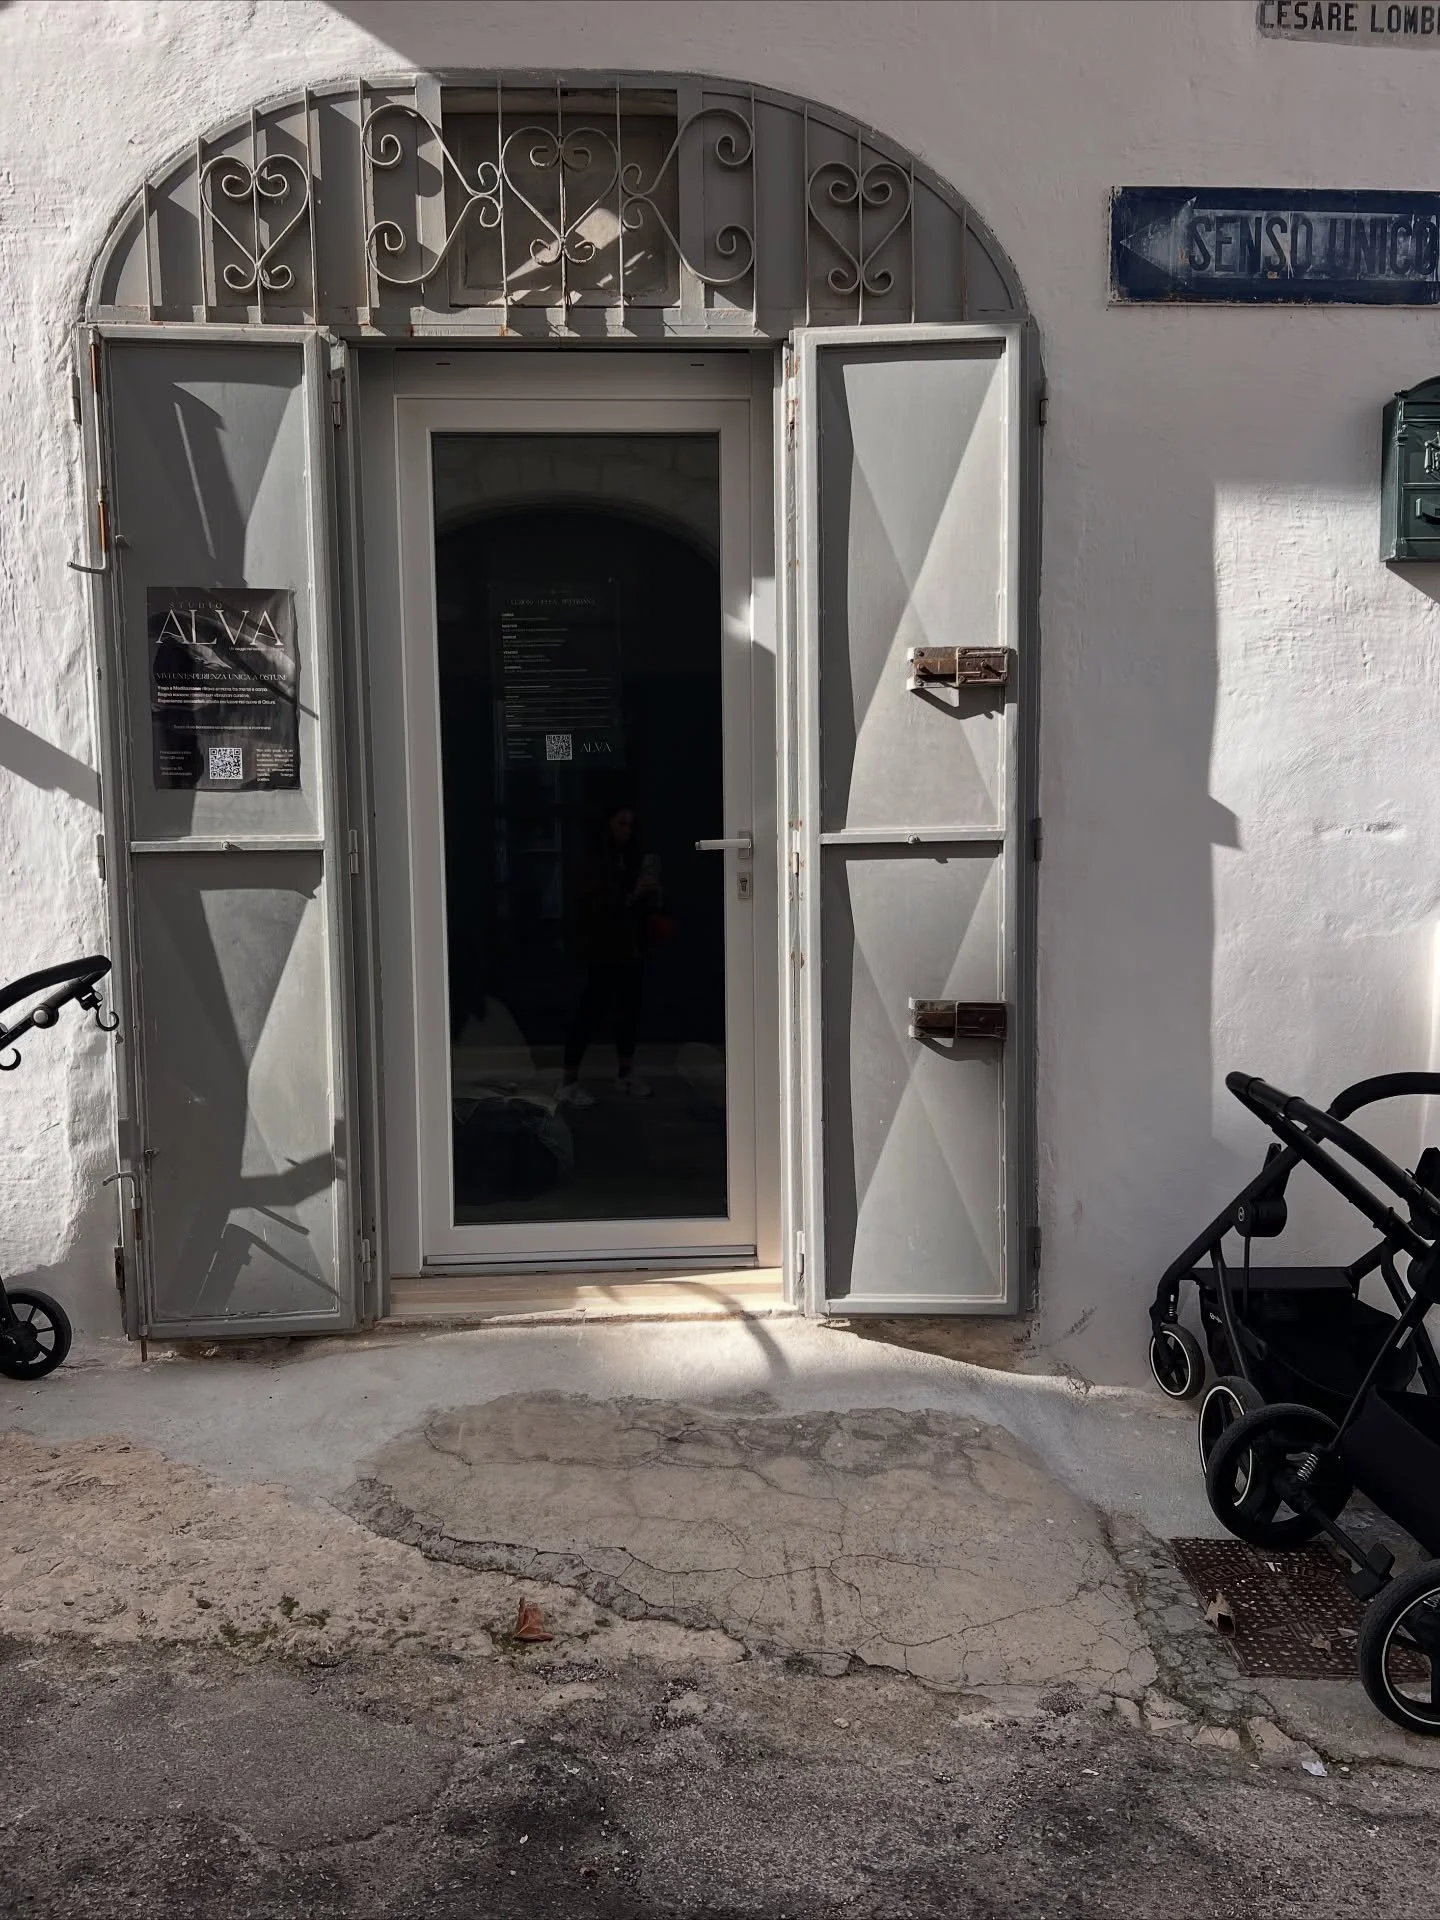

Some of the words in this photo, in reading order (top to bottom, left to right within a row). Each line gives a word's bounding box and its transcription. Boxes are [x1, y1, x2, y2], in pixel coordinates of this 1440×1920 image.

[1260, 1, 1358, 31] CESARE
[1371, 4, 1440, 35] LOMB
[1188, 216, 1313, 275] SENSO
[155, 609, 284, 646] ALVA
[581, 742, 613, 754] ALVA
